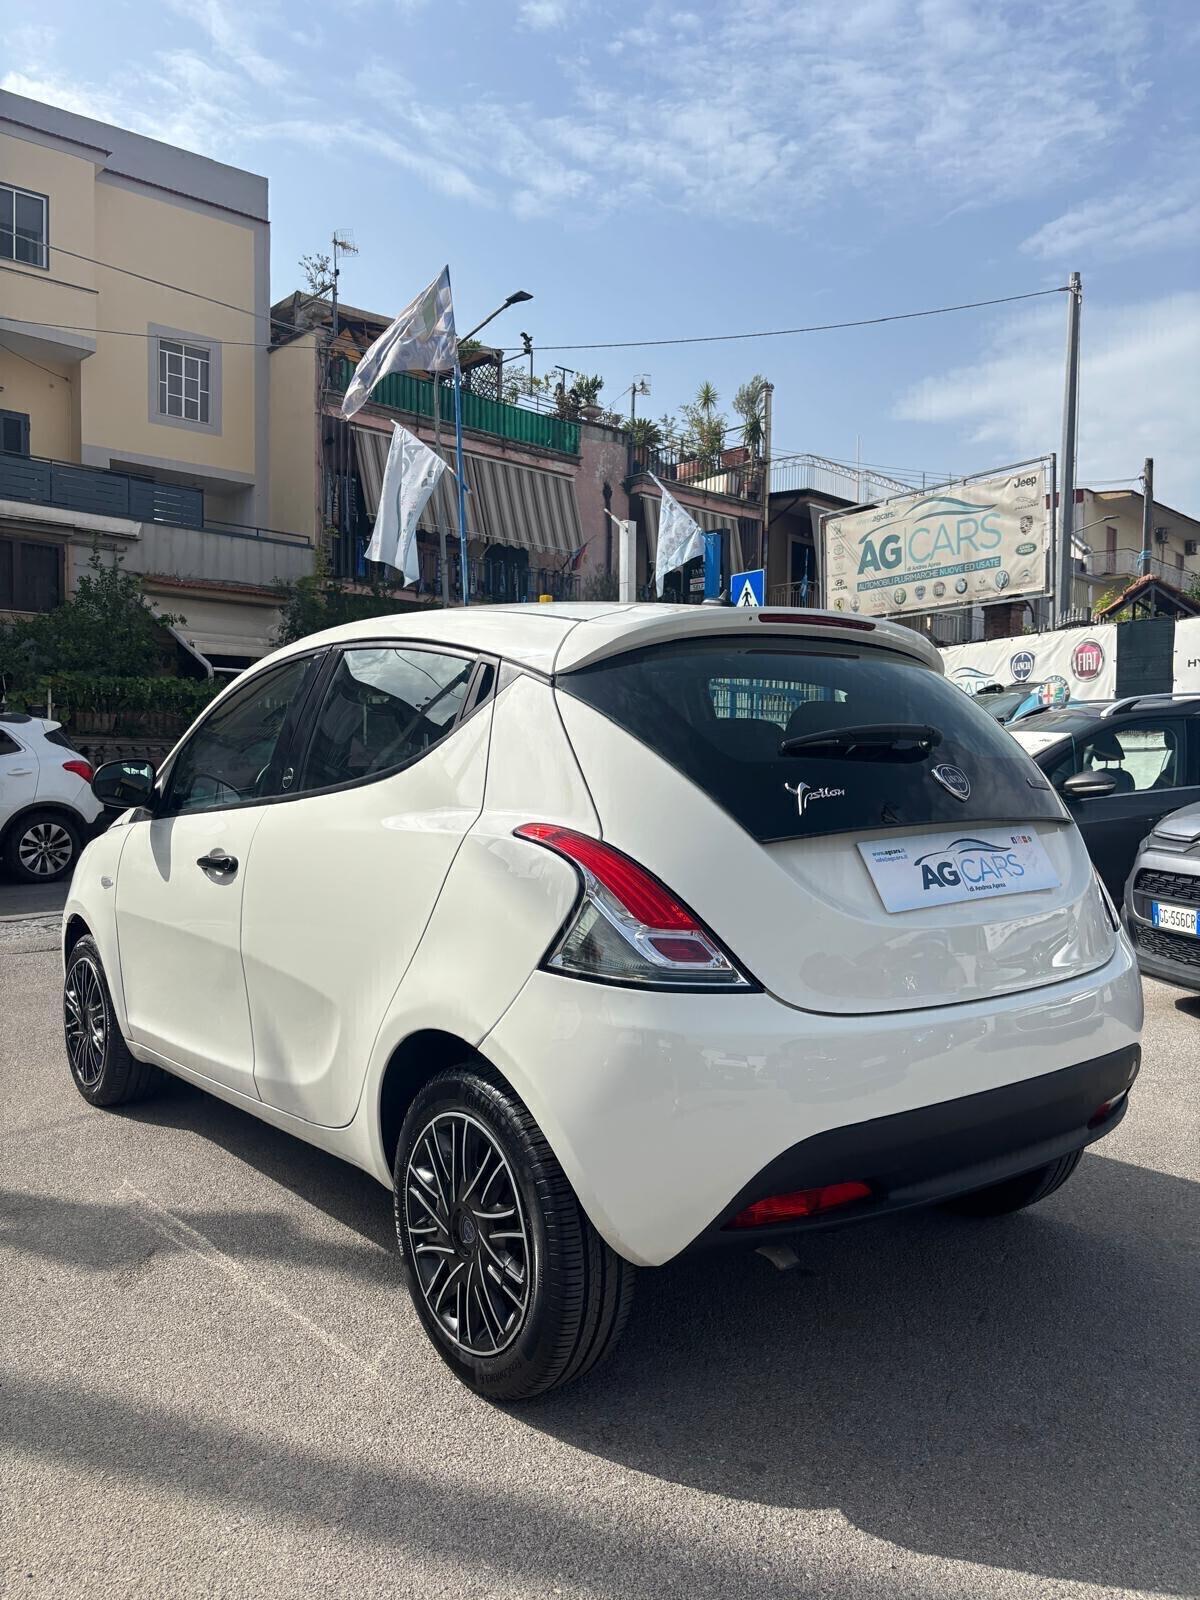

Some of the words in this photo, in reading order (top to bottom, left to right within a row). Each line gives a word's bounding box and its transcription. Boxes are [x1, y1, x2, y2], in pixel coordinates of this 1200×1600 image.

[1014, 475, 1037, 489] Jeep
[857, 534, 902, 575] AG
[908, 512, 1002, 564] CARS
[858, 578, 894, 590] AUTOMOBILI
[894, 569, 940, 584] PLURIMARCHE
[940, 564, 963, 576] NUOVE
[964, 563, 975, 571] ED
[976, 558, 1000, 569] USATE
[1077, 651, 1097, 671] FIAT
[784, 781, 845, 816] Ypsilon
[920, 860, 962, 891] AG
[960, 853, 1025, 883] CARS
